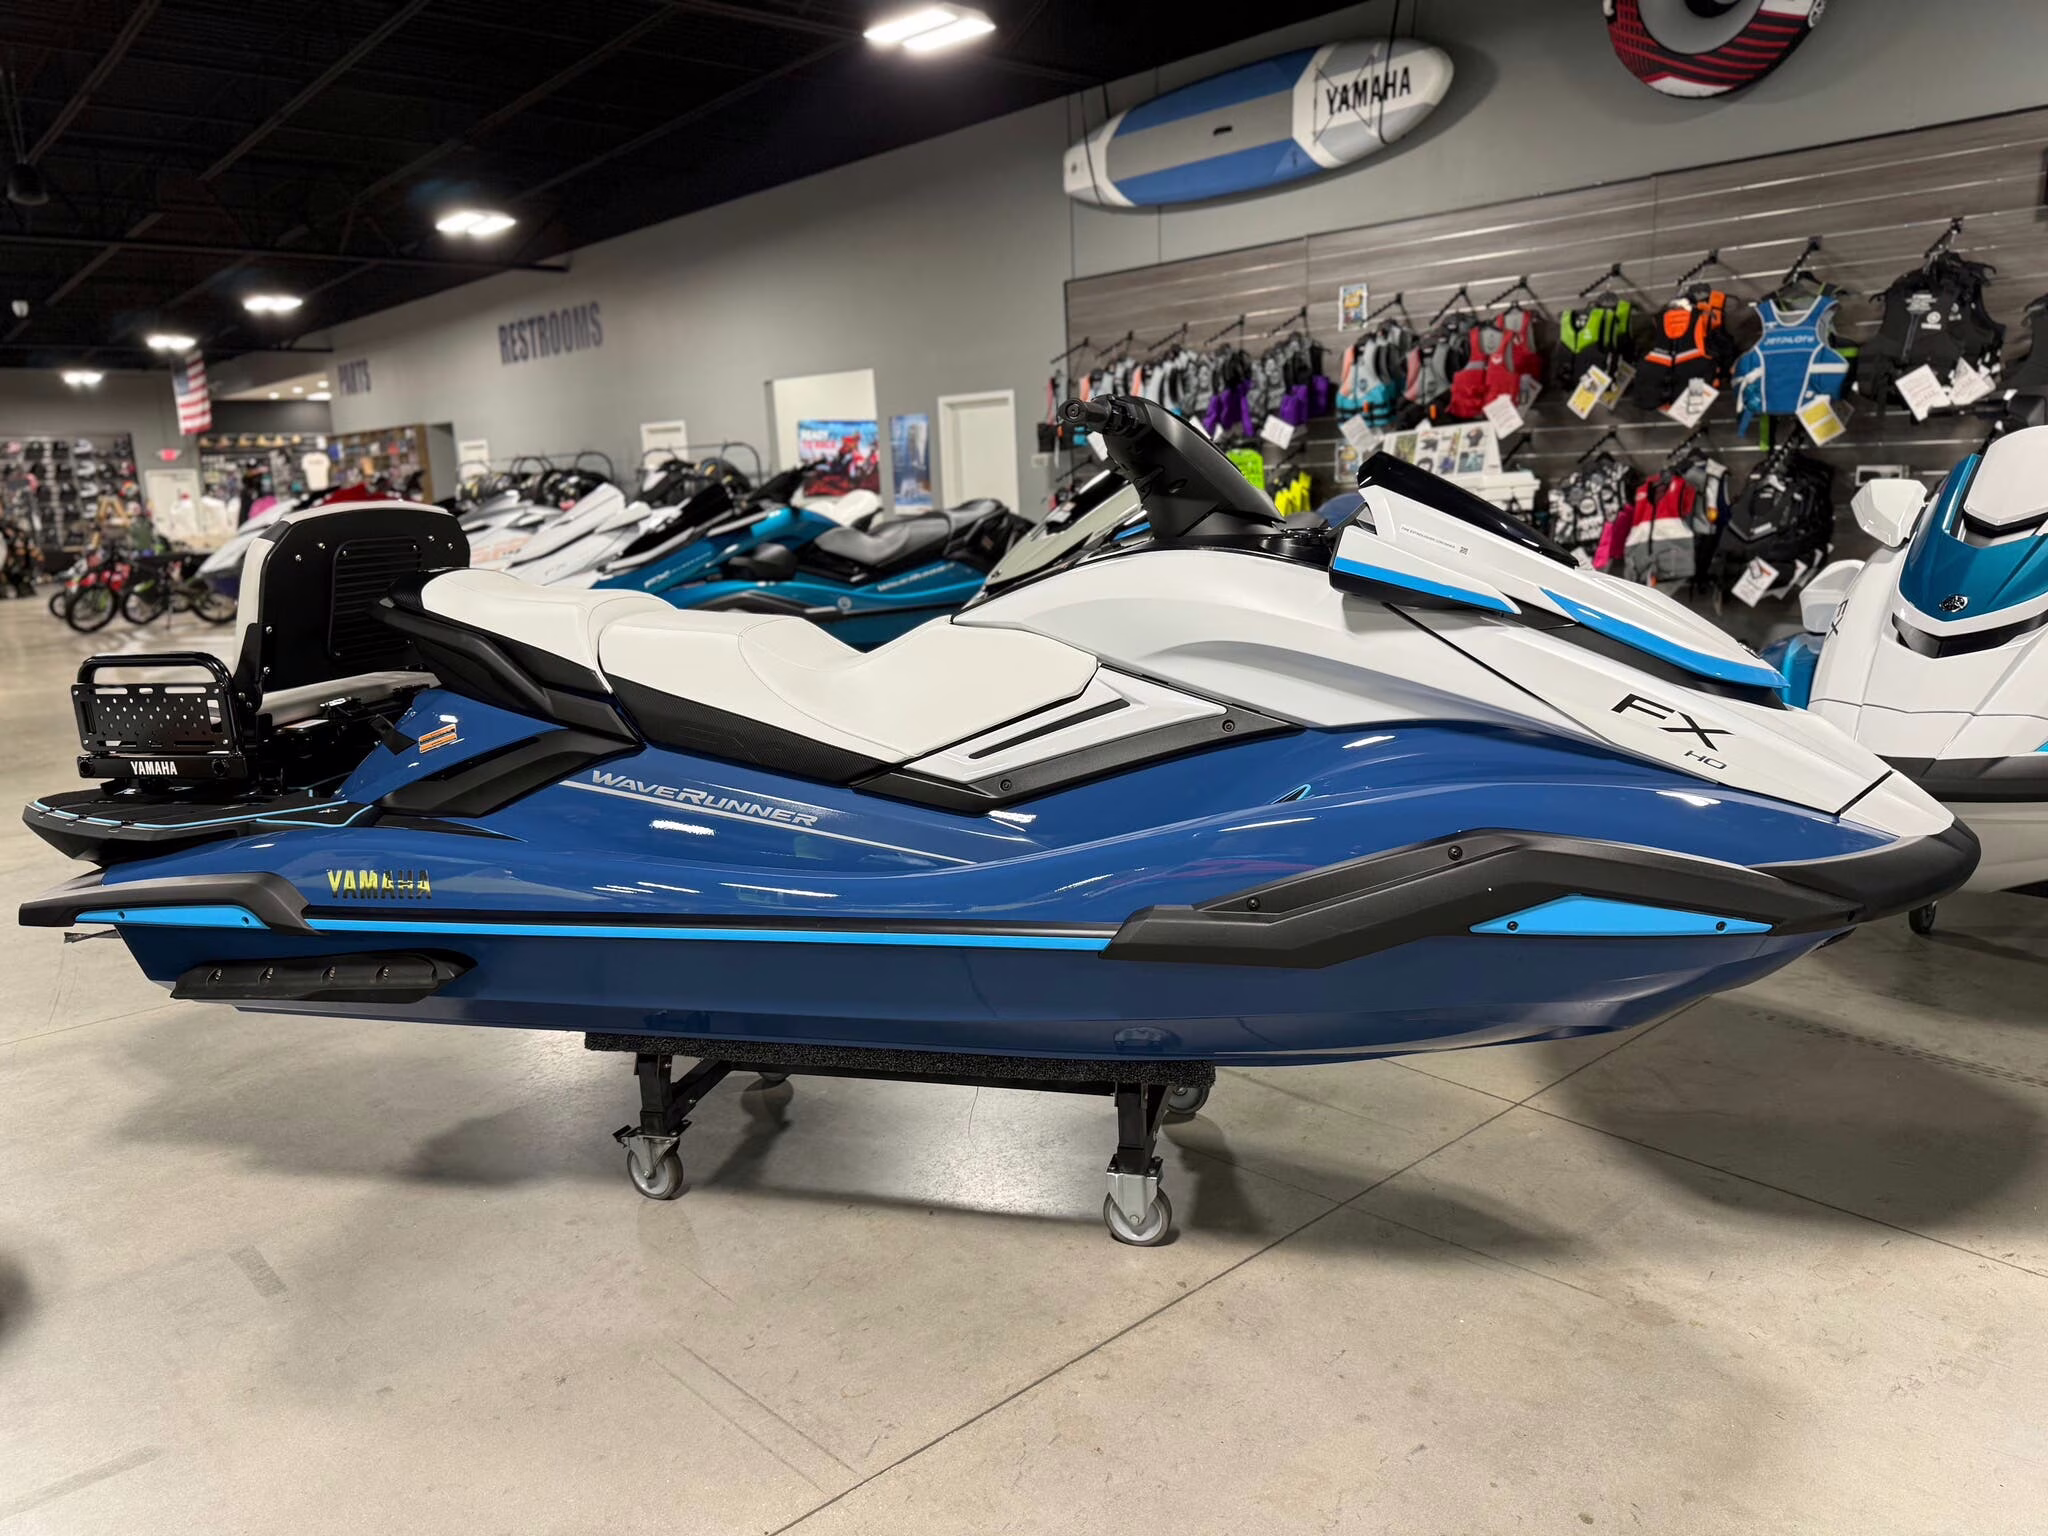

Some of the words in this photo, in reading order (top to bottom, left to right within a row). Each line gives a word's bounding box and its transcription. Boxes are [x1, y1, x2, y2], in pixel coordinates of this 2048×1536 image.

[1326, 66, 1411, 115] YAMAHA
[498, 301, 604, 366] RESTROOMS
[1611, 693, 1735, 752] FX
[130, 761, 178, 775] YAMAHA
[1684, 750, 1727, 770] HO
[327, 868, 433, 899] YAMAHA
